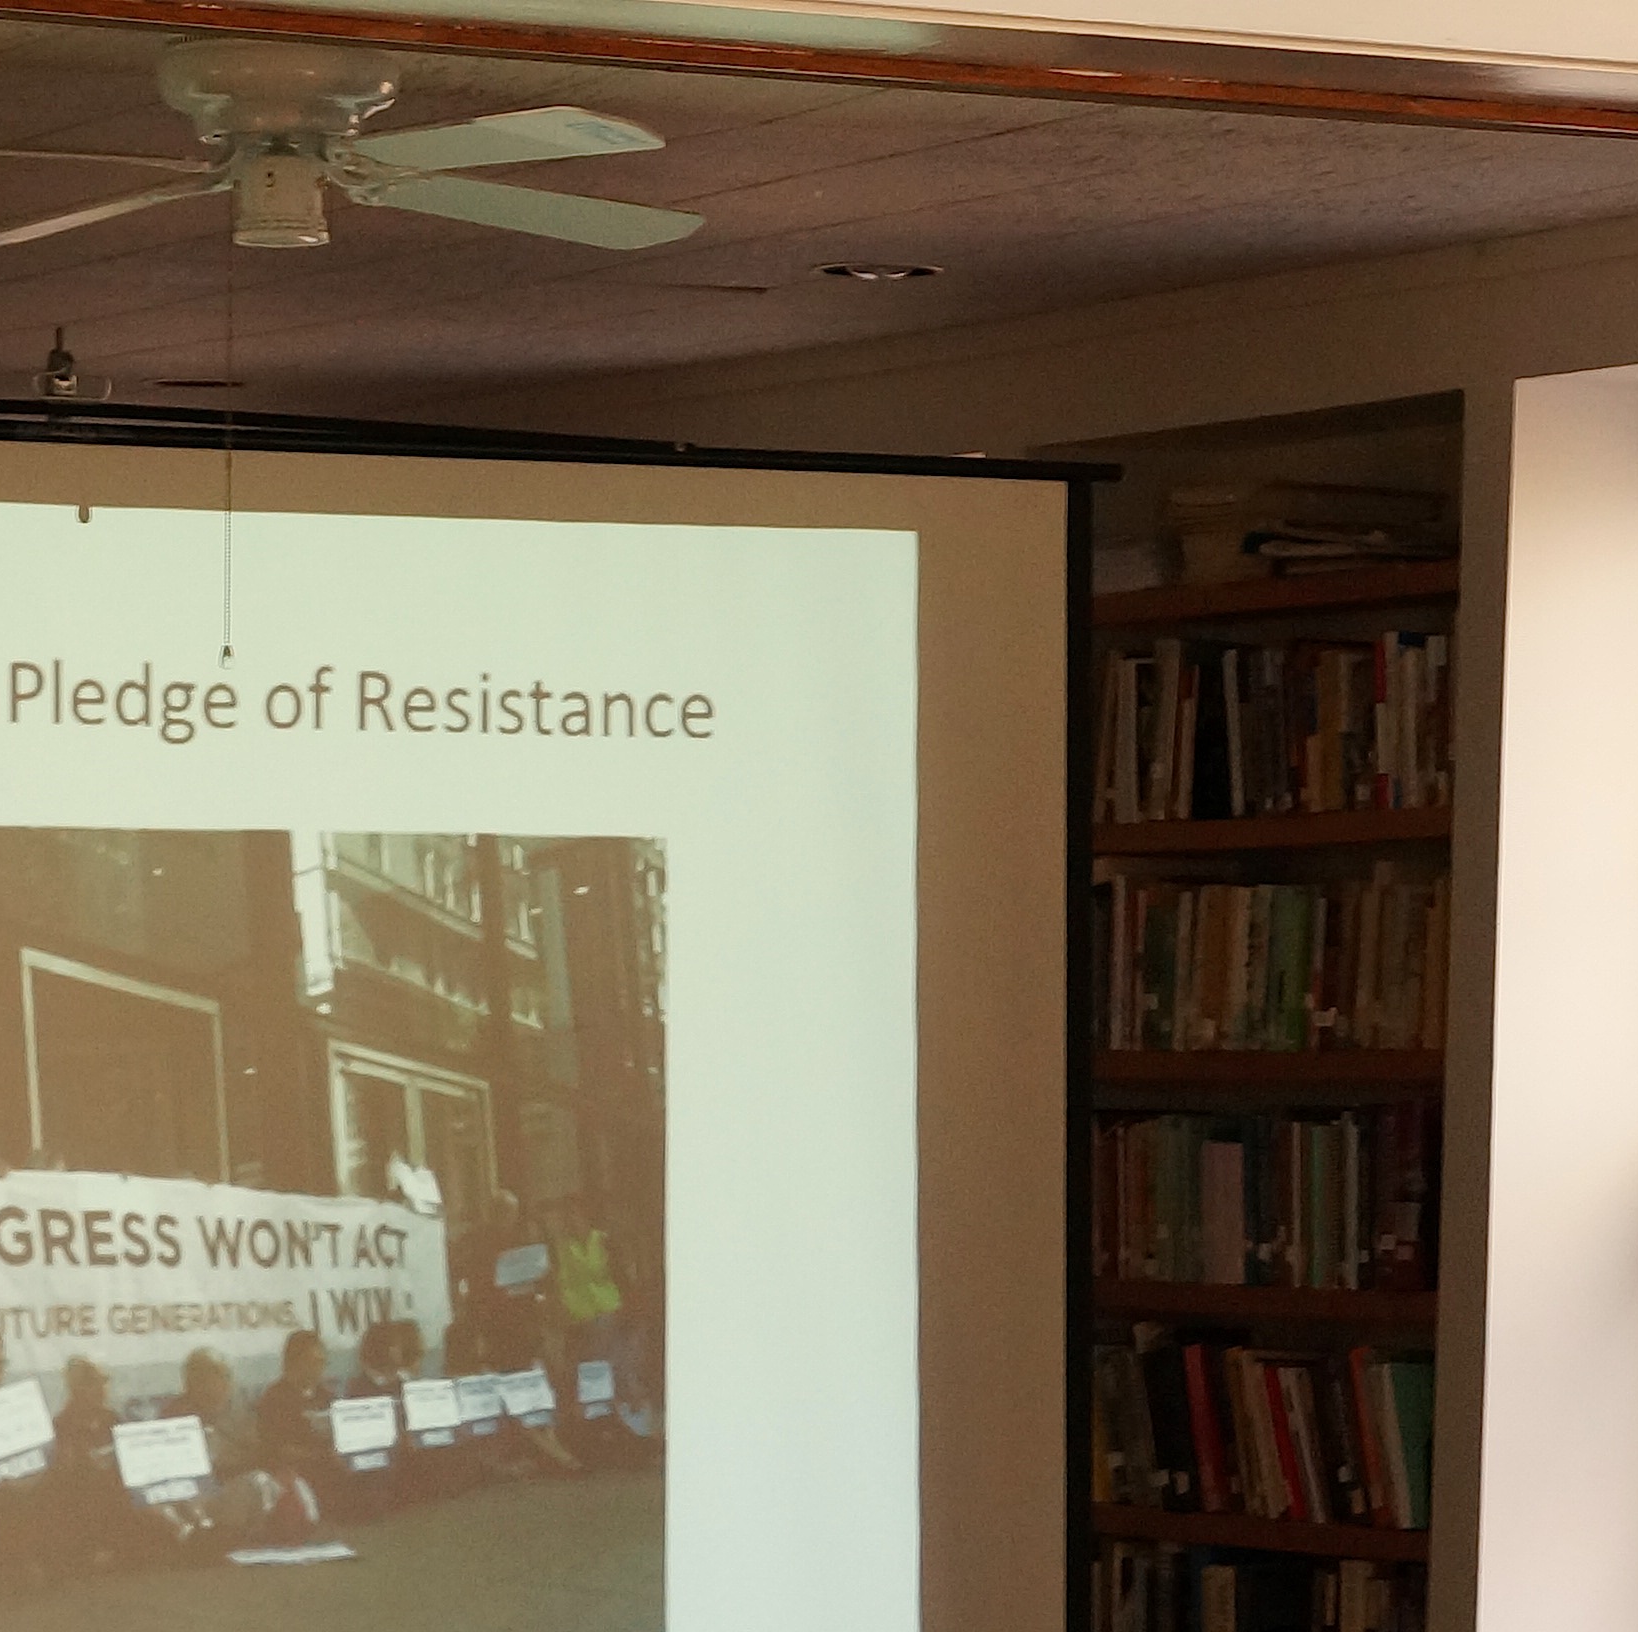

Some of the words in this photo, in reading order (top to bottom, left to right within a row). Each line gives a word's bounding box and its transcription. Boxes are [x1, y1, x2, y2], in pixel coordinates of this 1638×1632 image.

[8, 659, 240, 744] Pledge
[265, 665, 336, 730] of
[358, 671, 715, 738] Resistance
[354, 1223, 409, 1269] ACT
